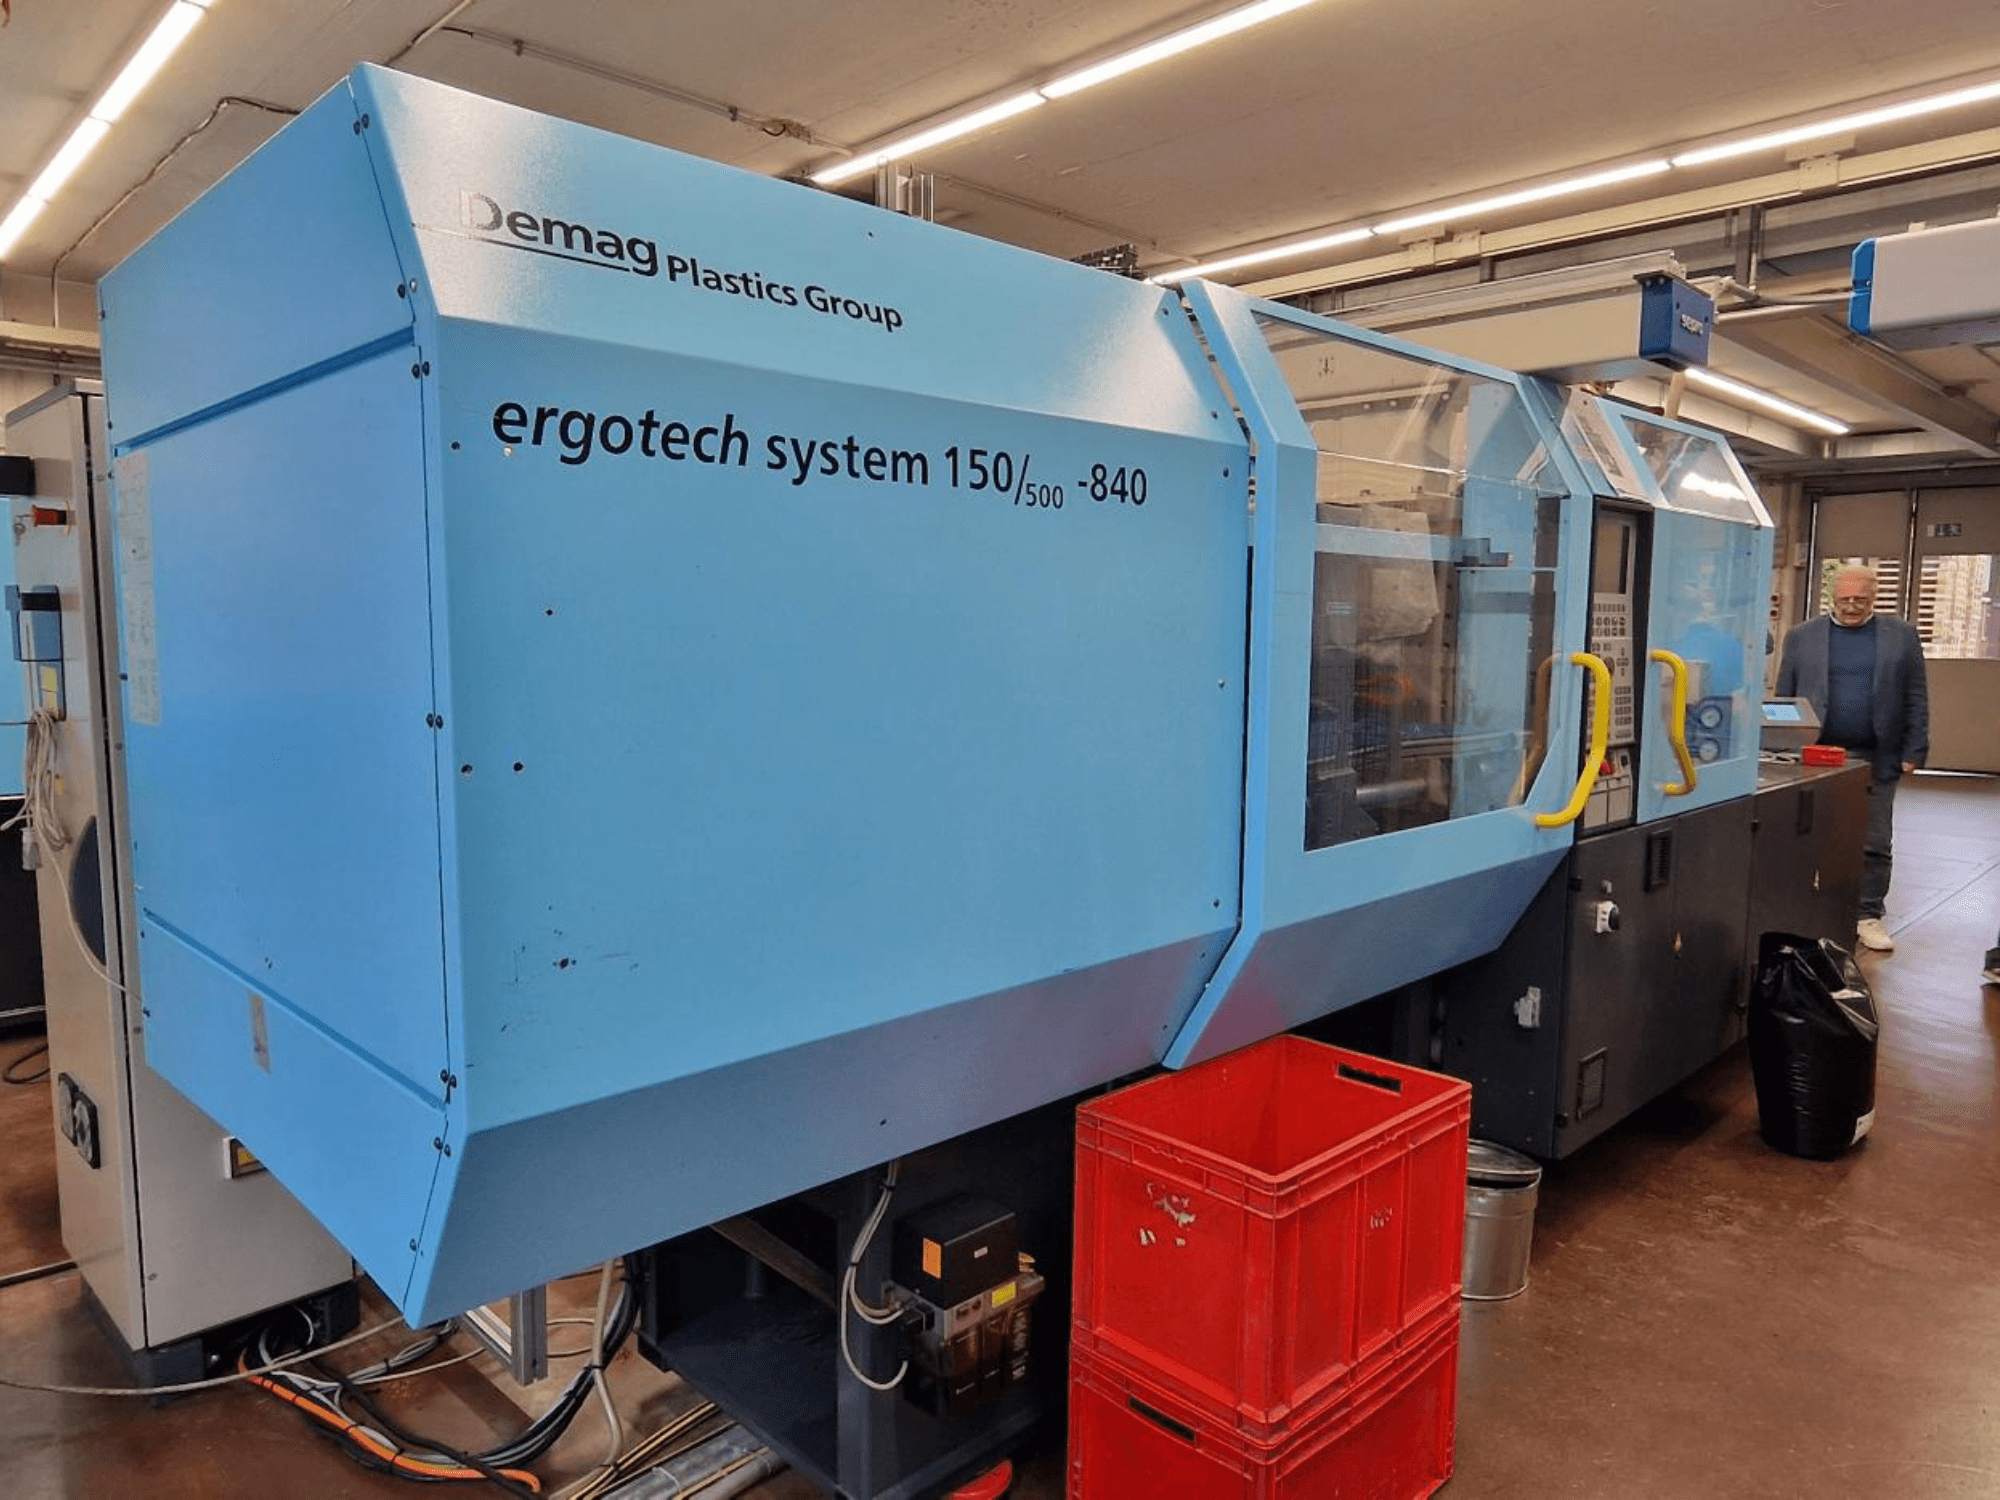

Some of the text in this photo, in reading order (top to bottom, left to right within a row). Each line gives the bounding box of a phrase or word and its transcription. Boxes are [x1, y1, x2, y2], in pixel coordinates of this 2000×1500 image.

[460, 189, 903, 333] Demag Plastics Group
[492, 402, 749, 467] ergotech
[767, 434, 929, 486] system
[1078, 463, 1147, 506] -840
